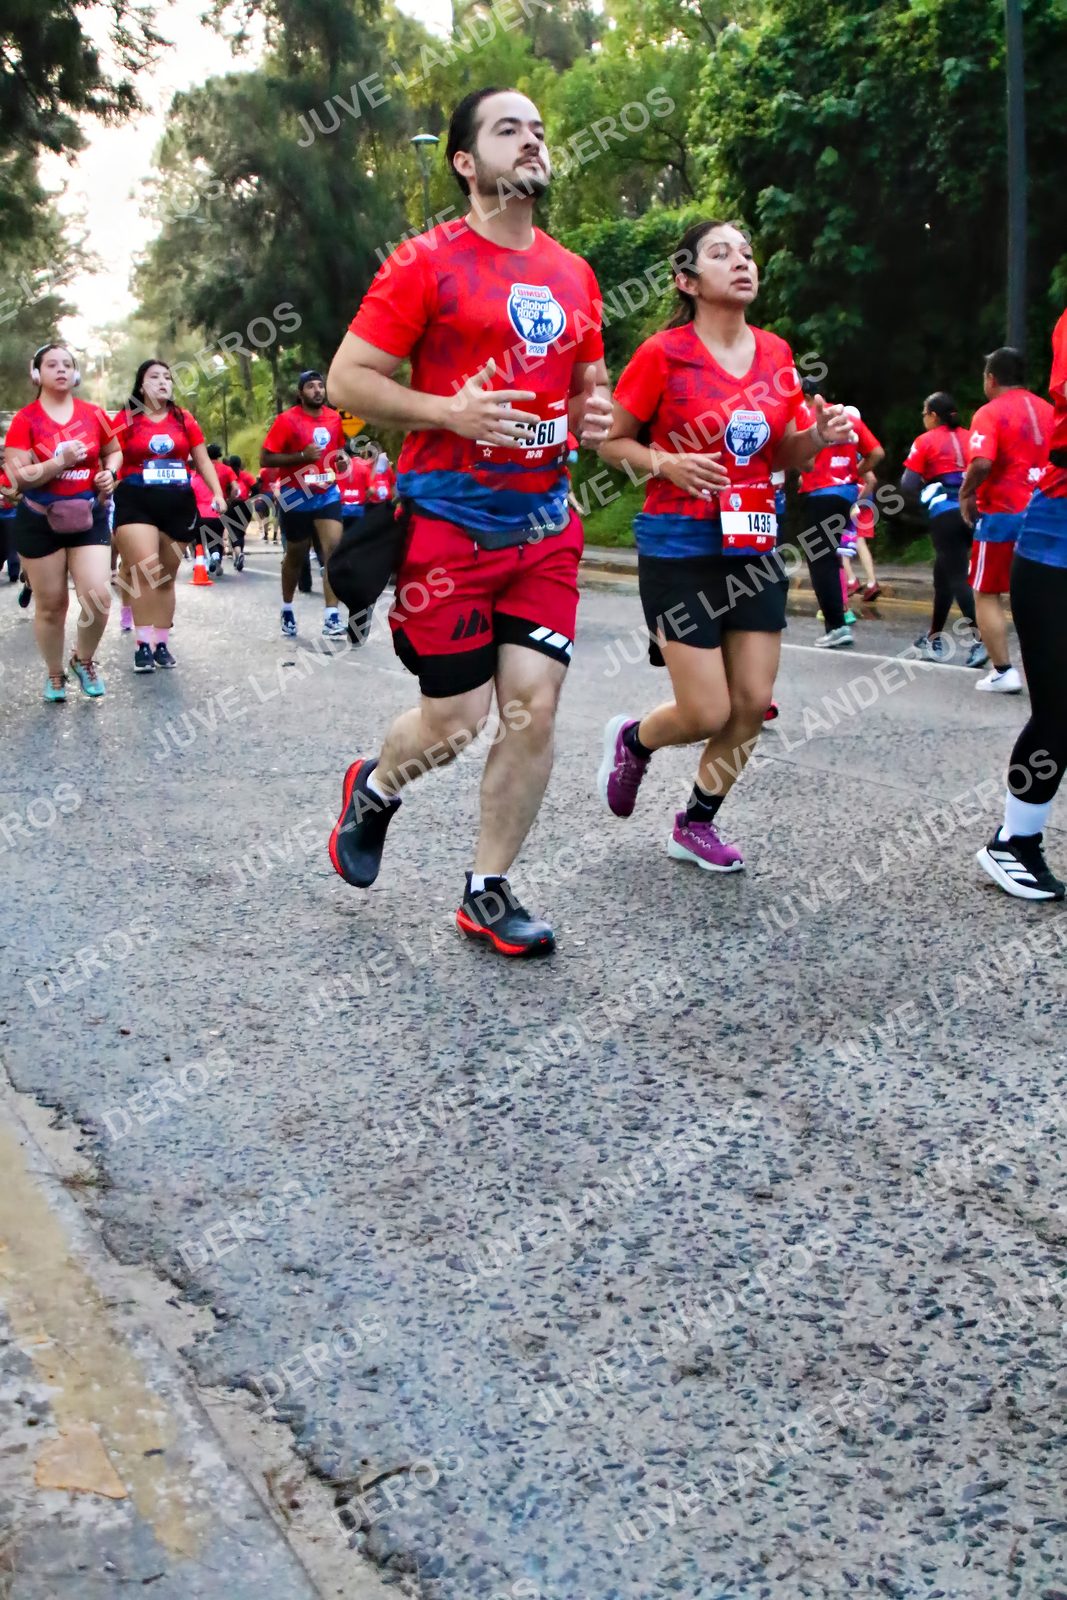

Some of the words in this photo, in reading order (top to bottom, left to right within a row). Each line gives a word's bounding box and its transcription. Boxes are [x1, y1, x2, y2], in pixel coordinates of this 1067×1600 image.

[520, 300, 549, 312] Global
[517, 307, 540, 319] Race
[528, 345, 545, 354] 2026
[747, 513, 771, 533] 1435
